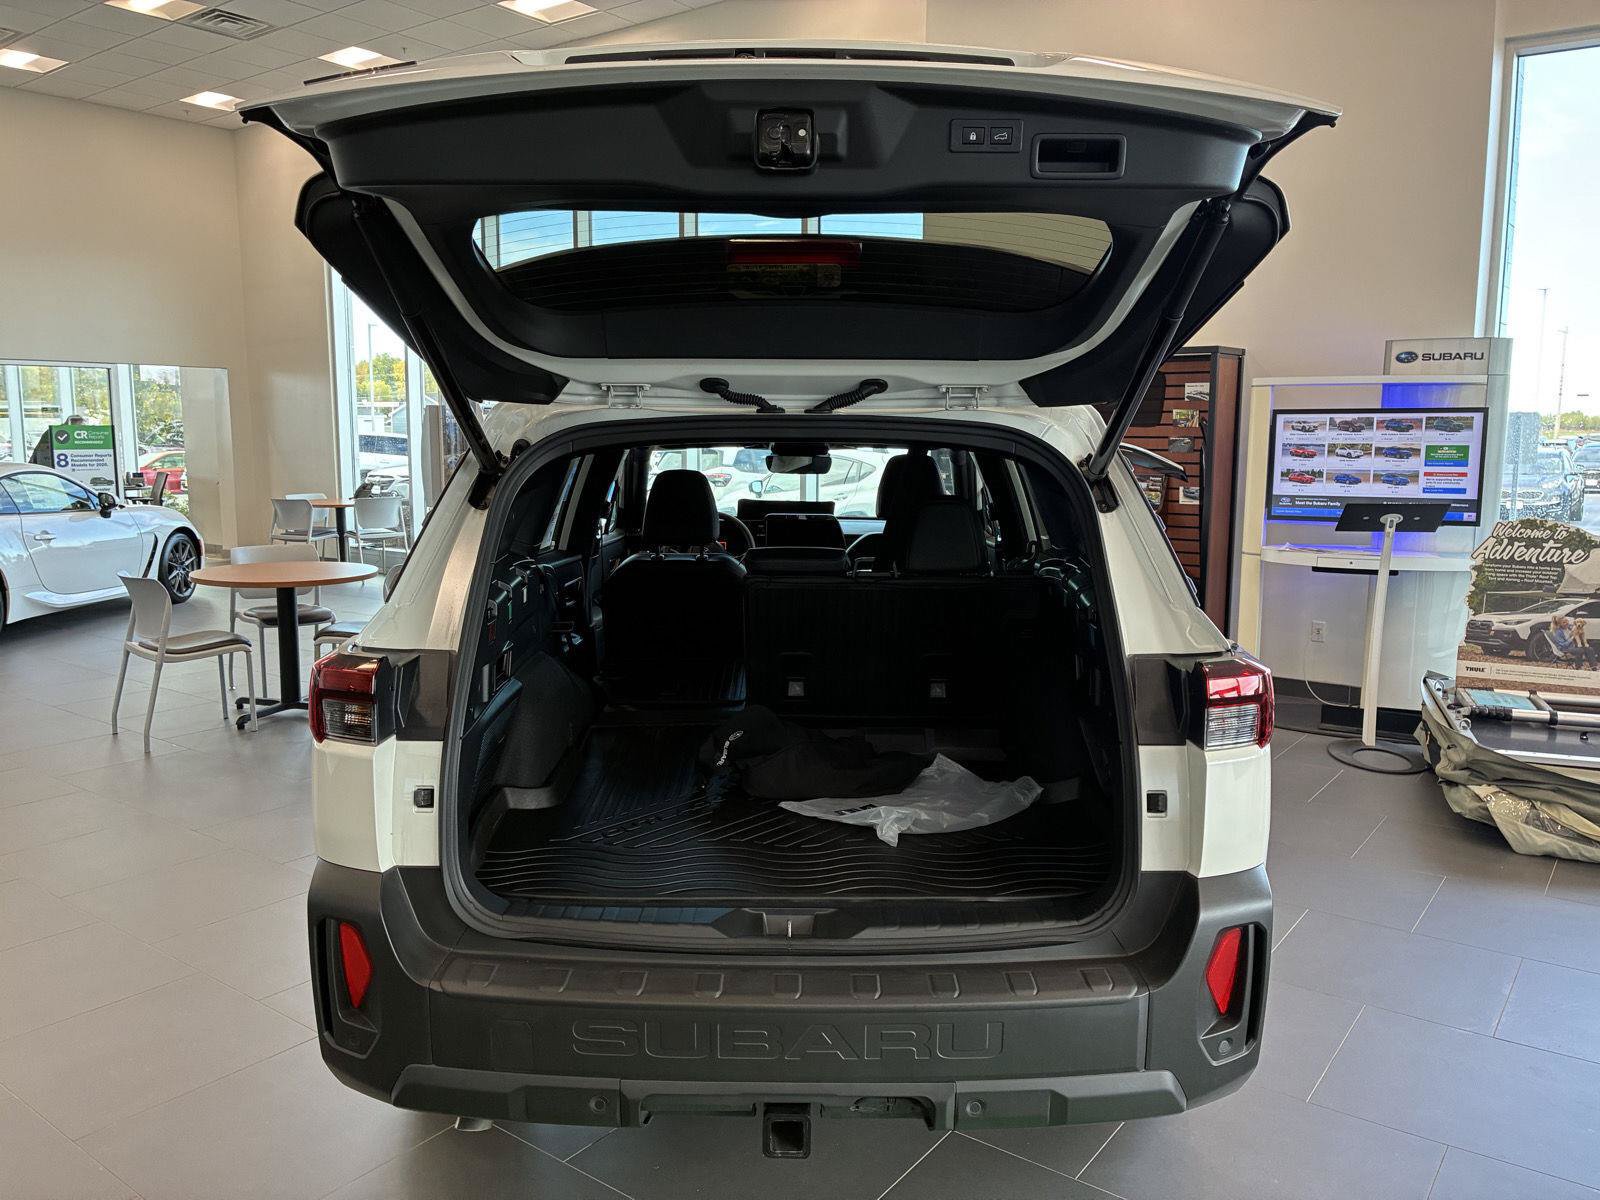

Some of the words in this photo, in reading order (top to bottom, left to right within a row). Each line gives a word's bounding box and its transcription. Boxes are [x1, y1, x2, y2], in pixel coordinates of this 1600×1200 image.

[1421, 352, 1484, 361] SUBARU
[74, 430, 88, 439] CR
[56, 453, 69, 468] 8
[1493, 522, 1552, 539] Welcome
[1554, 526, 1569, 539] to
[1472, 536, 1588, 563] Adventure
[572, 1019, 1005, 1060] SUBARU
